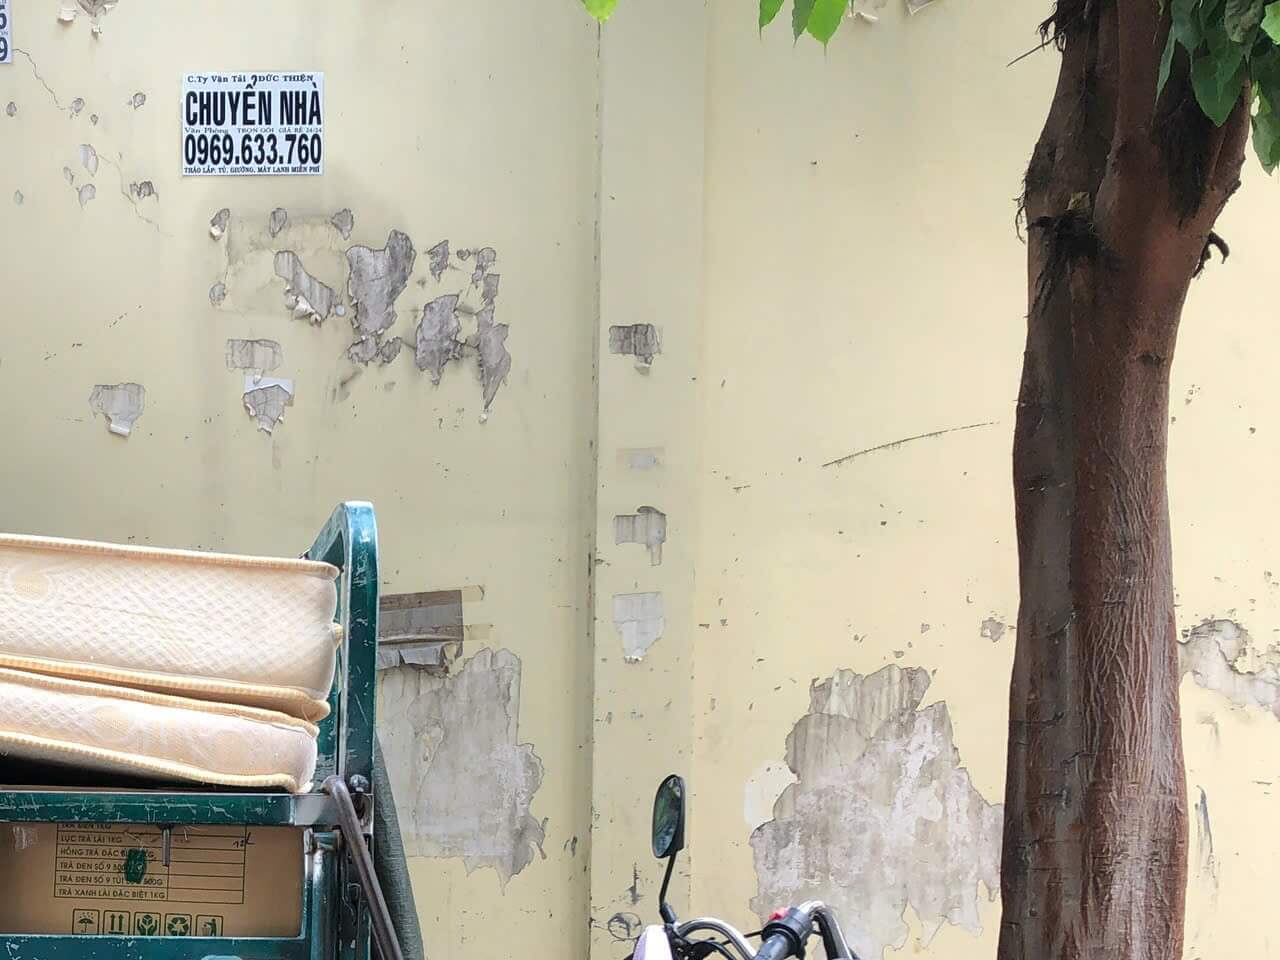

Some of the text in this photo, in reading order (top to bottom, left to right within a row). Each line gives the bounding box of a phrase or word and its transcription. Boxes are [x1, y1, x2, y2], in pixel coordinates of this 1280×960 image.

[187, 75, 208, 84] C.Ty
[185, 74, 322, 126] CHUYỂN NHÀ
[185, 134, 322, 165] 0969.633.760
